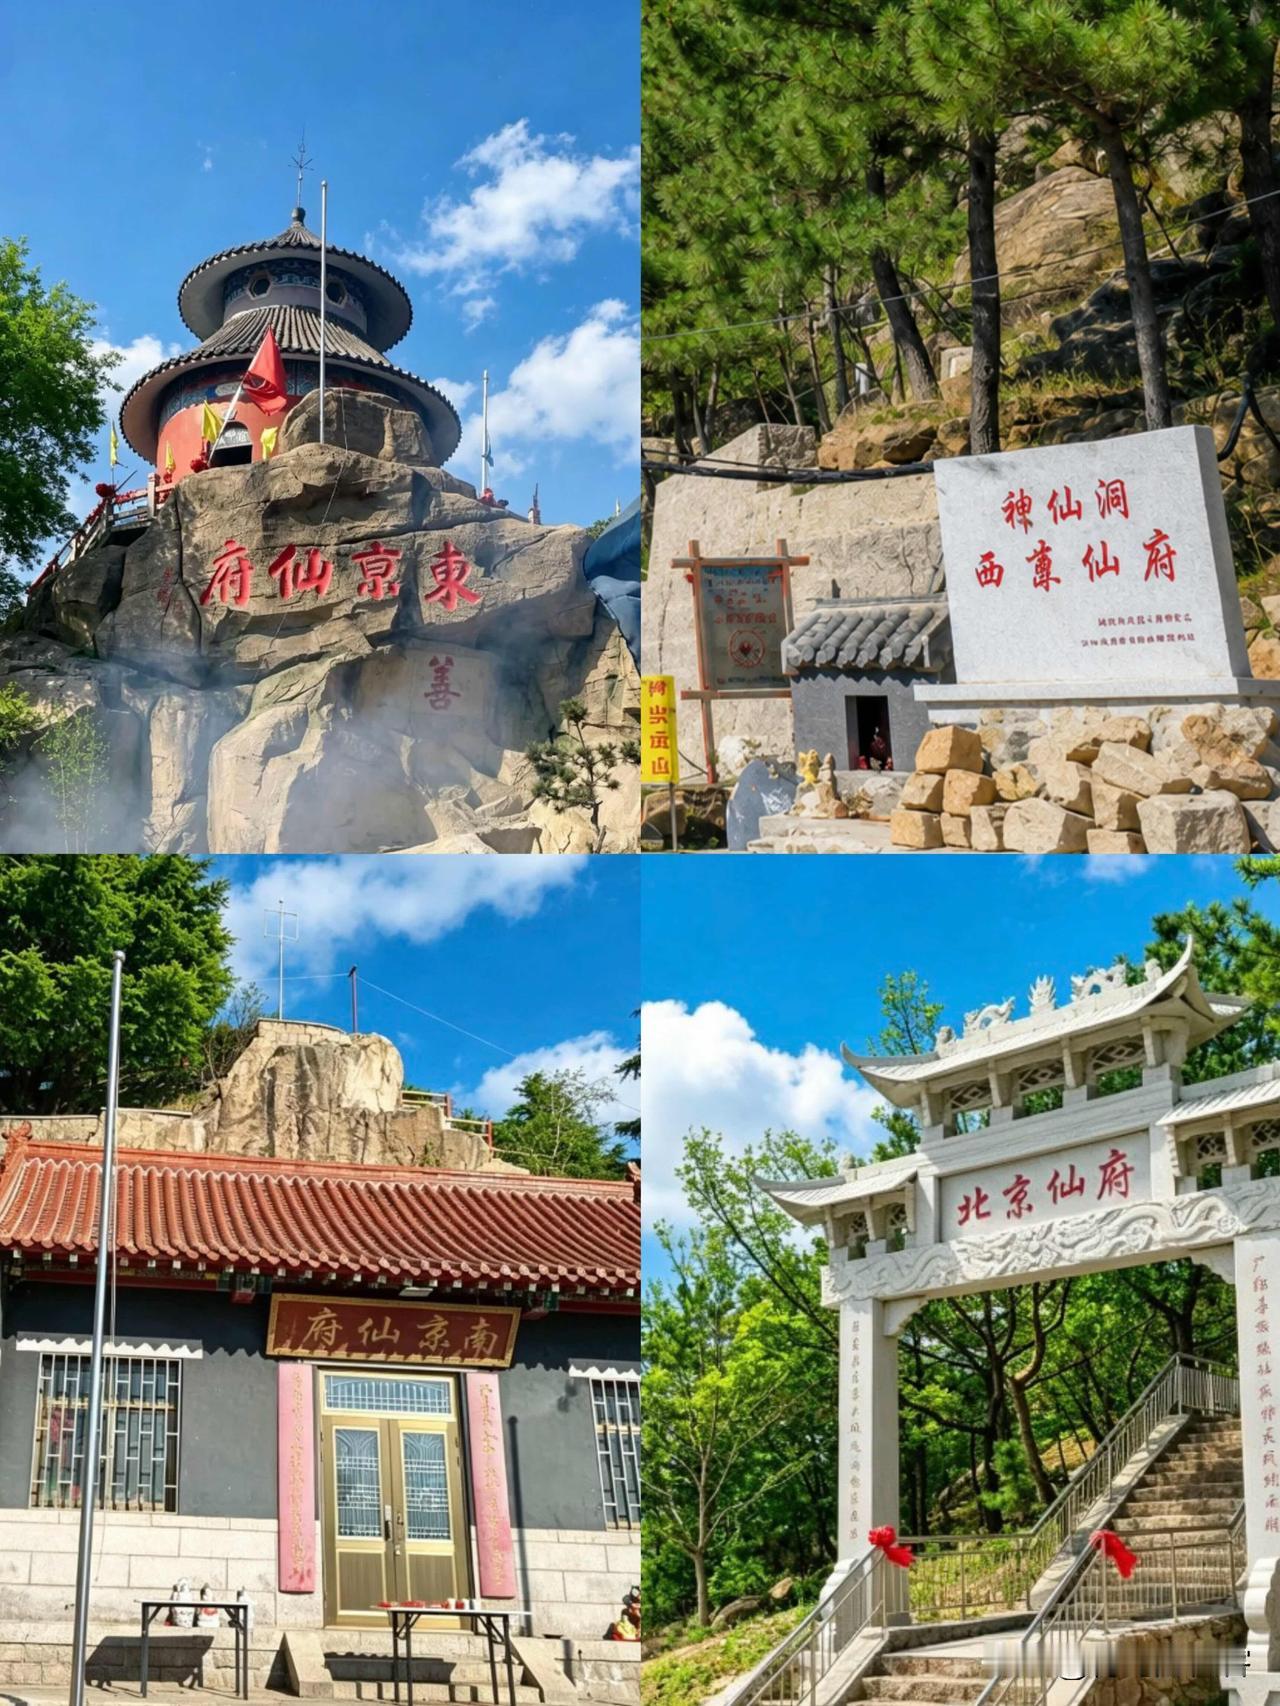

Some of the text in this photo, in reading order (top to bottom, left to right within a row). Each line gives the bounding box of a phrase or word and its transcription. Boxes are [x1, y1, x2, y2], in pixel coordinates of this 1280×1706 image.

[1001, 478, 1130, 535] 神仙洞
[957, 1148, 1135, 1226] 北京仙府
